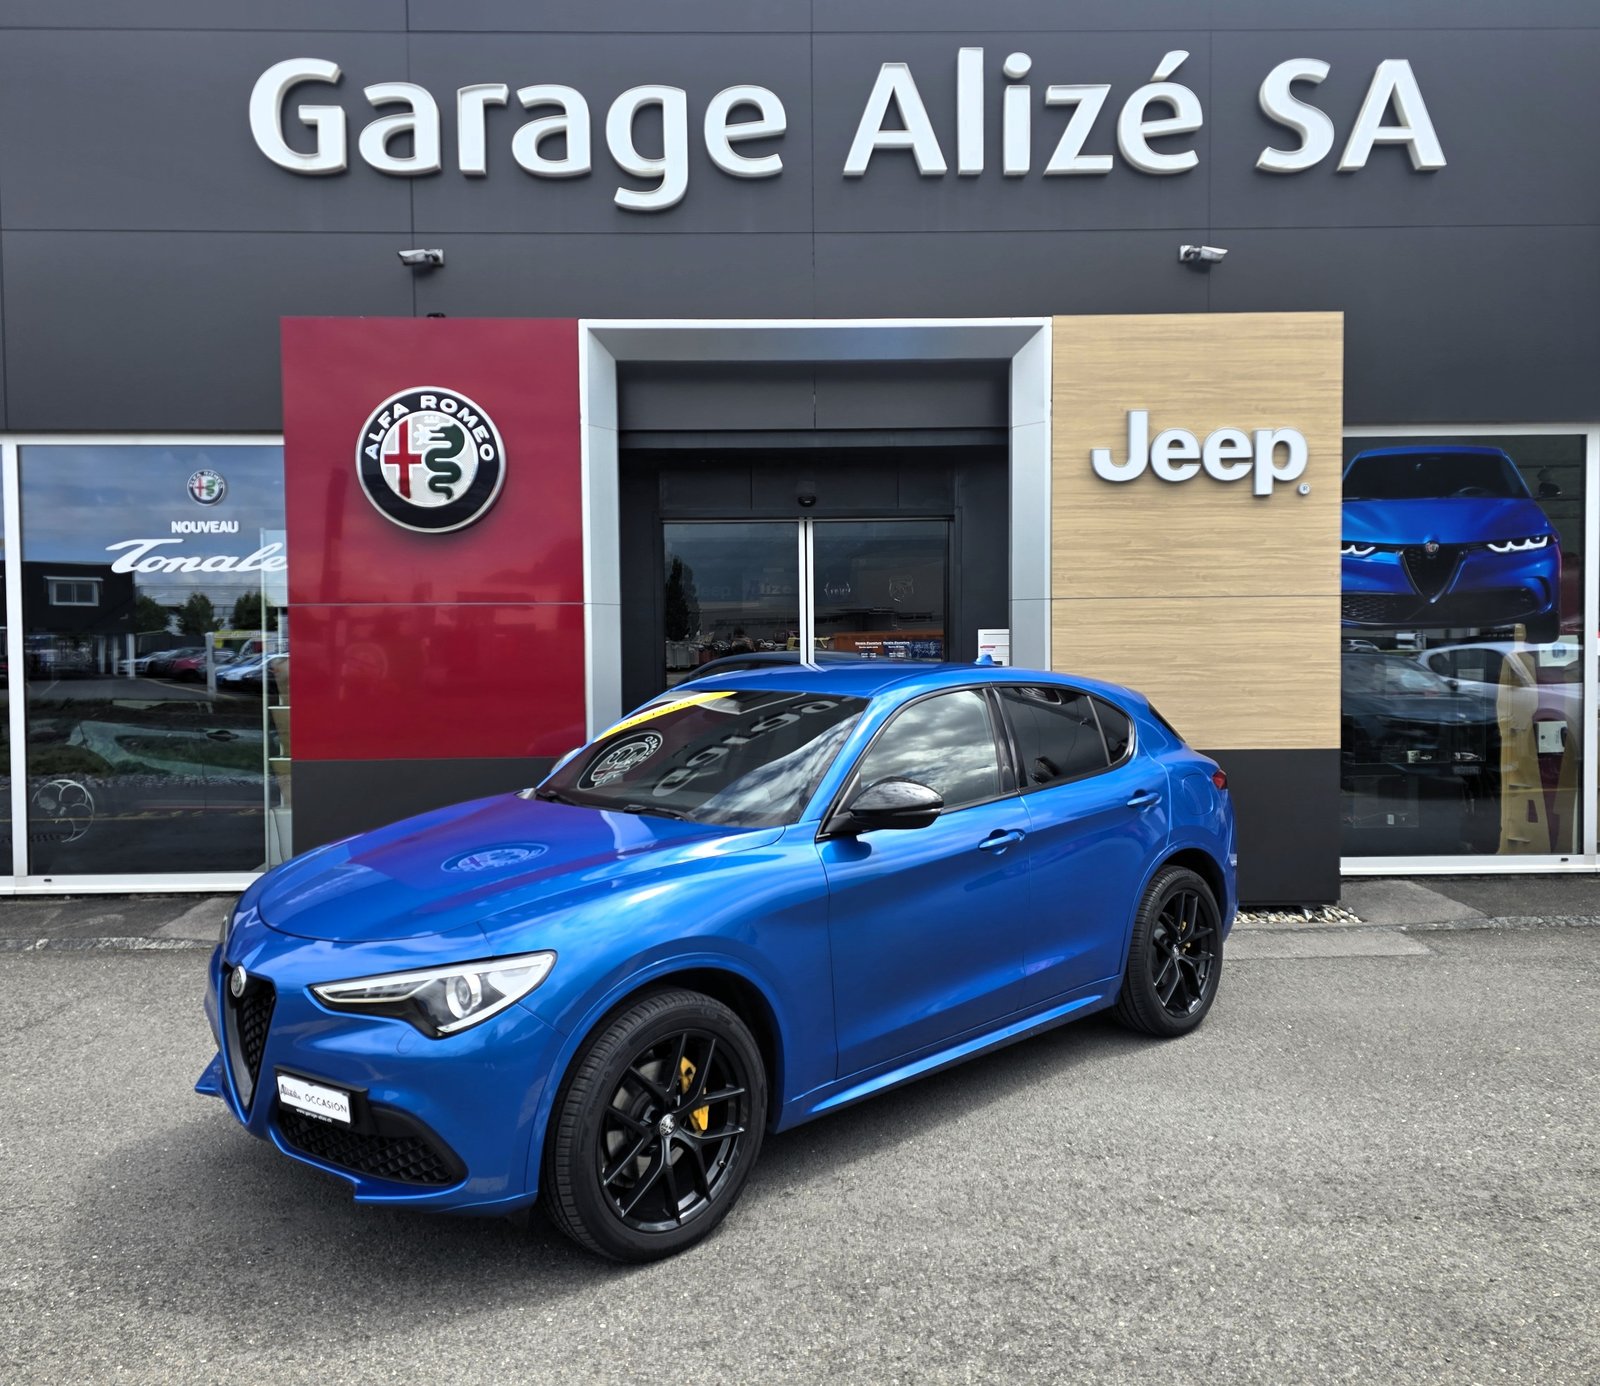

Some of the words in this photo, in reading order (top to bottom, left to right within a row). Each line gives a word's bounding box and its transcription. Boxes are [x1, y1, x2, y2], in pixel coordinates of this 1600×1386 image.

[249, 57, 788, 212] Garage
[843, 46, 1204, 176] Alizé
[1255, 57, 1448, 173] SA
[364, 402, 410, 460] ALFA
[420, 395, 495, 461] ROMEO
[1090, 409, 1309, 497] Jeep
[171, 520, 240, 534] NOUVEAU
[105, 538, 289, 574] Tonale
[304, 1093, 347, 1113] OCCASION
